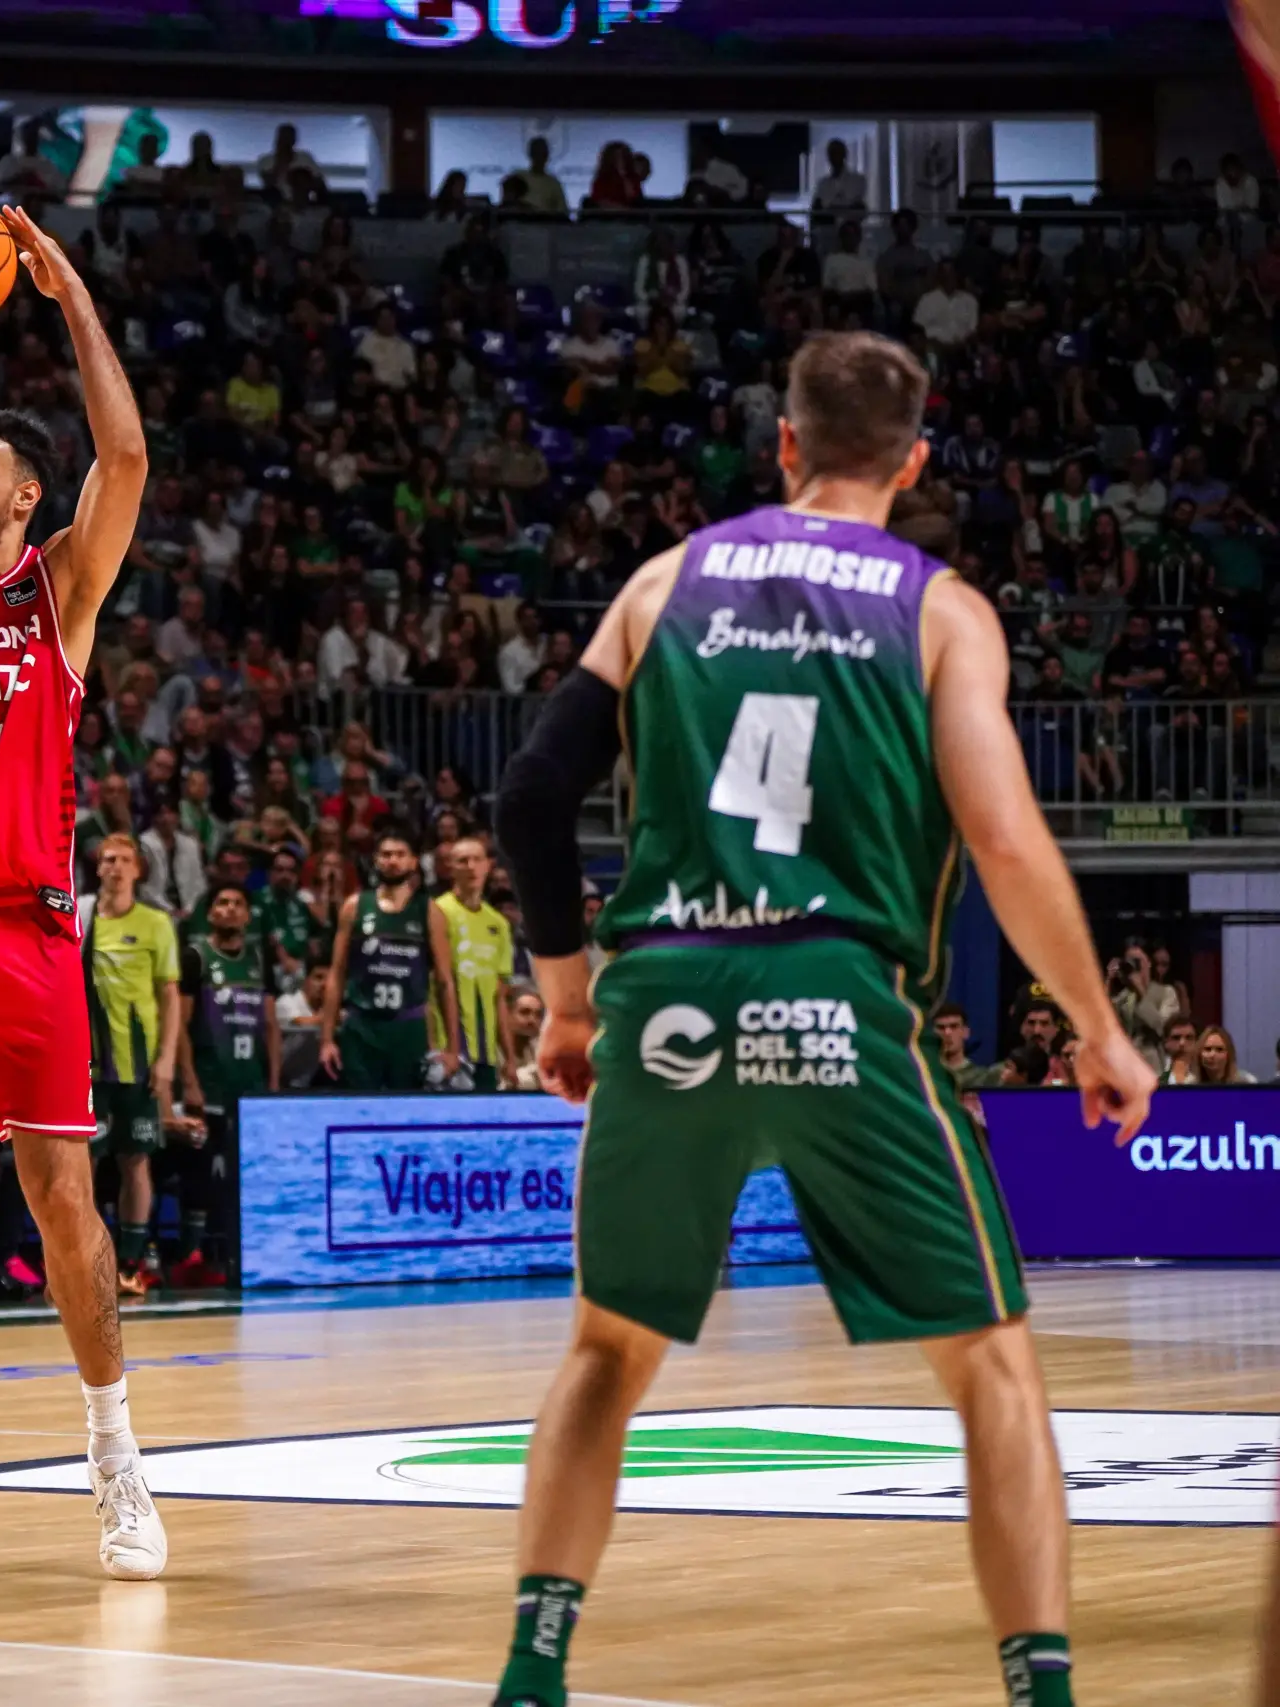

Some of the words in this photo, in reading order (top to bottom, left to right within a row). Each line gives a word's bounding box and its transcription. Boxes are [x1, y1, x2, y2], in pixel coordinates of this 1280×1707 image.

[700, 540, 905, 598] KALINOSKI
[708, 692, 820, 857] 4
[373, 983, 404, 1010] 33
[737, 998, 858, 1033] COSTA
[736, 1033, 797, 1060] DEL
[800, 1032, 860, 1060] SOL
[374, 1153, 512, 1229] Viajar
